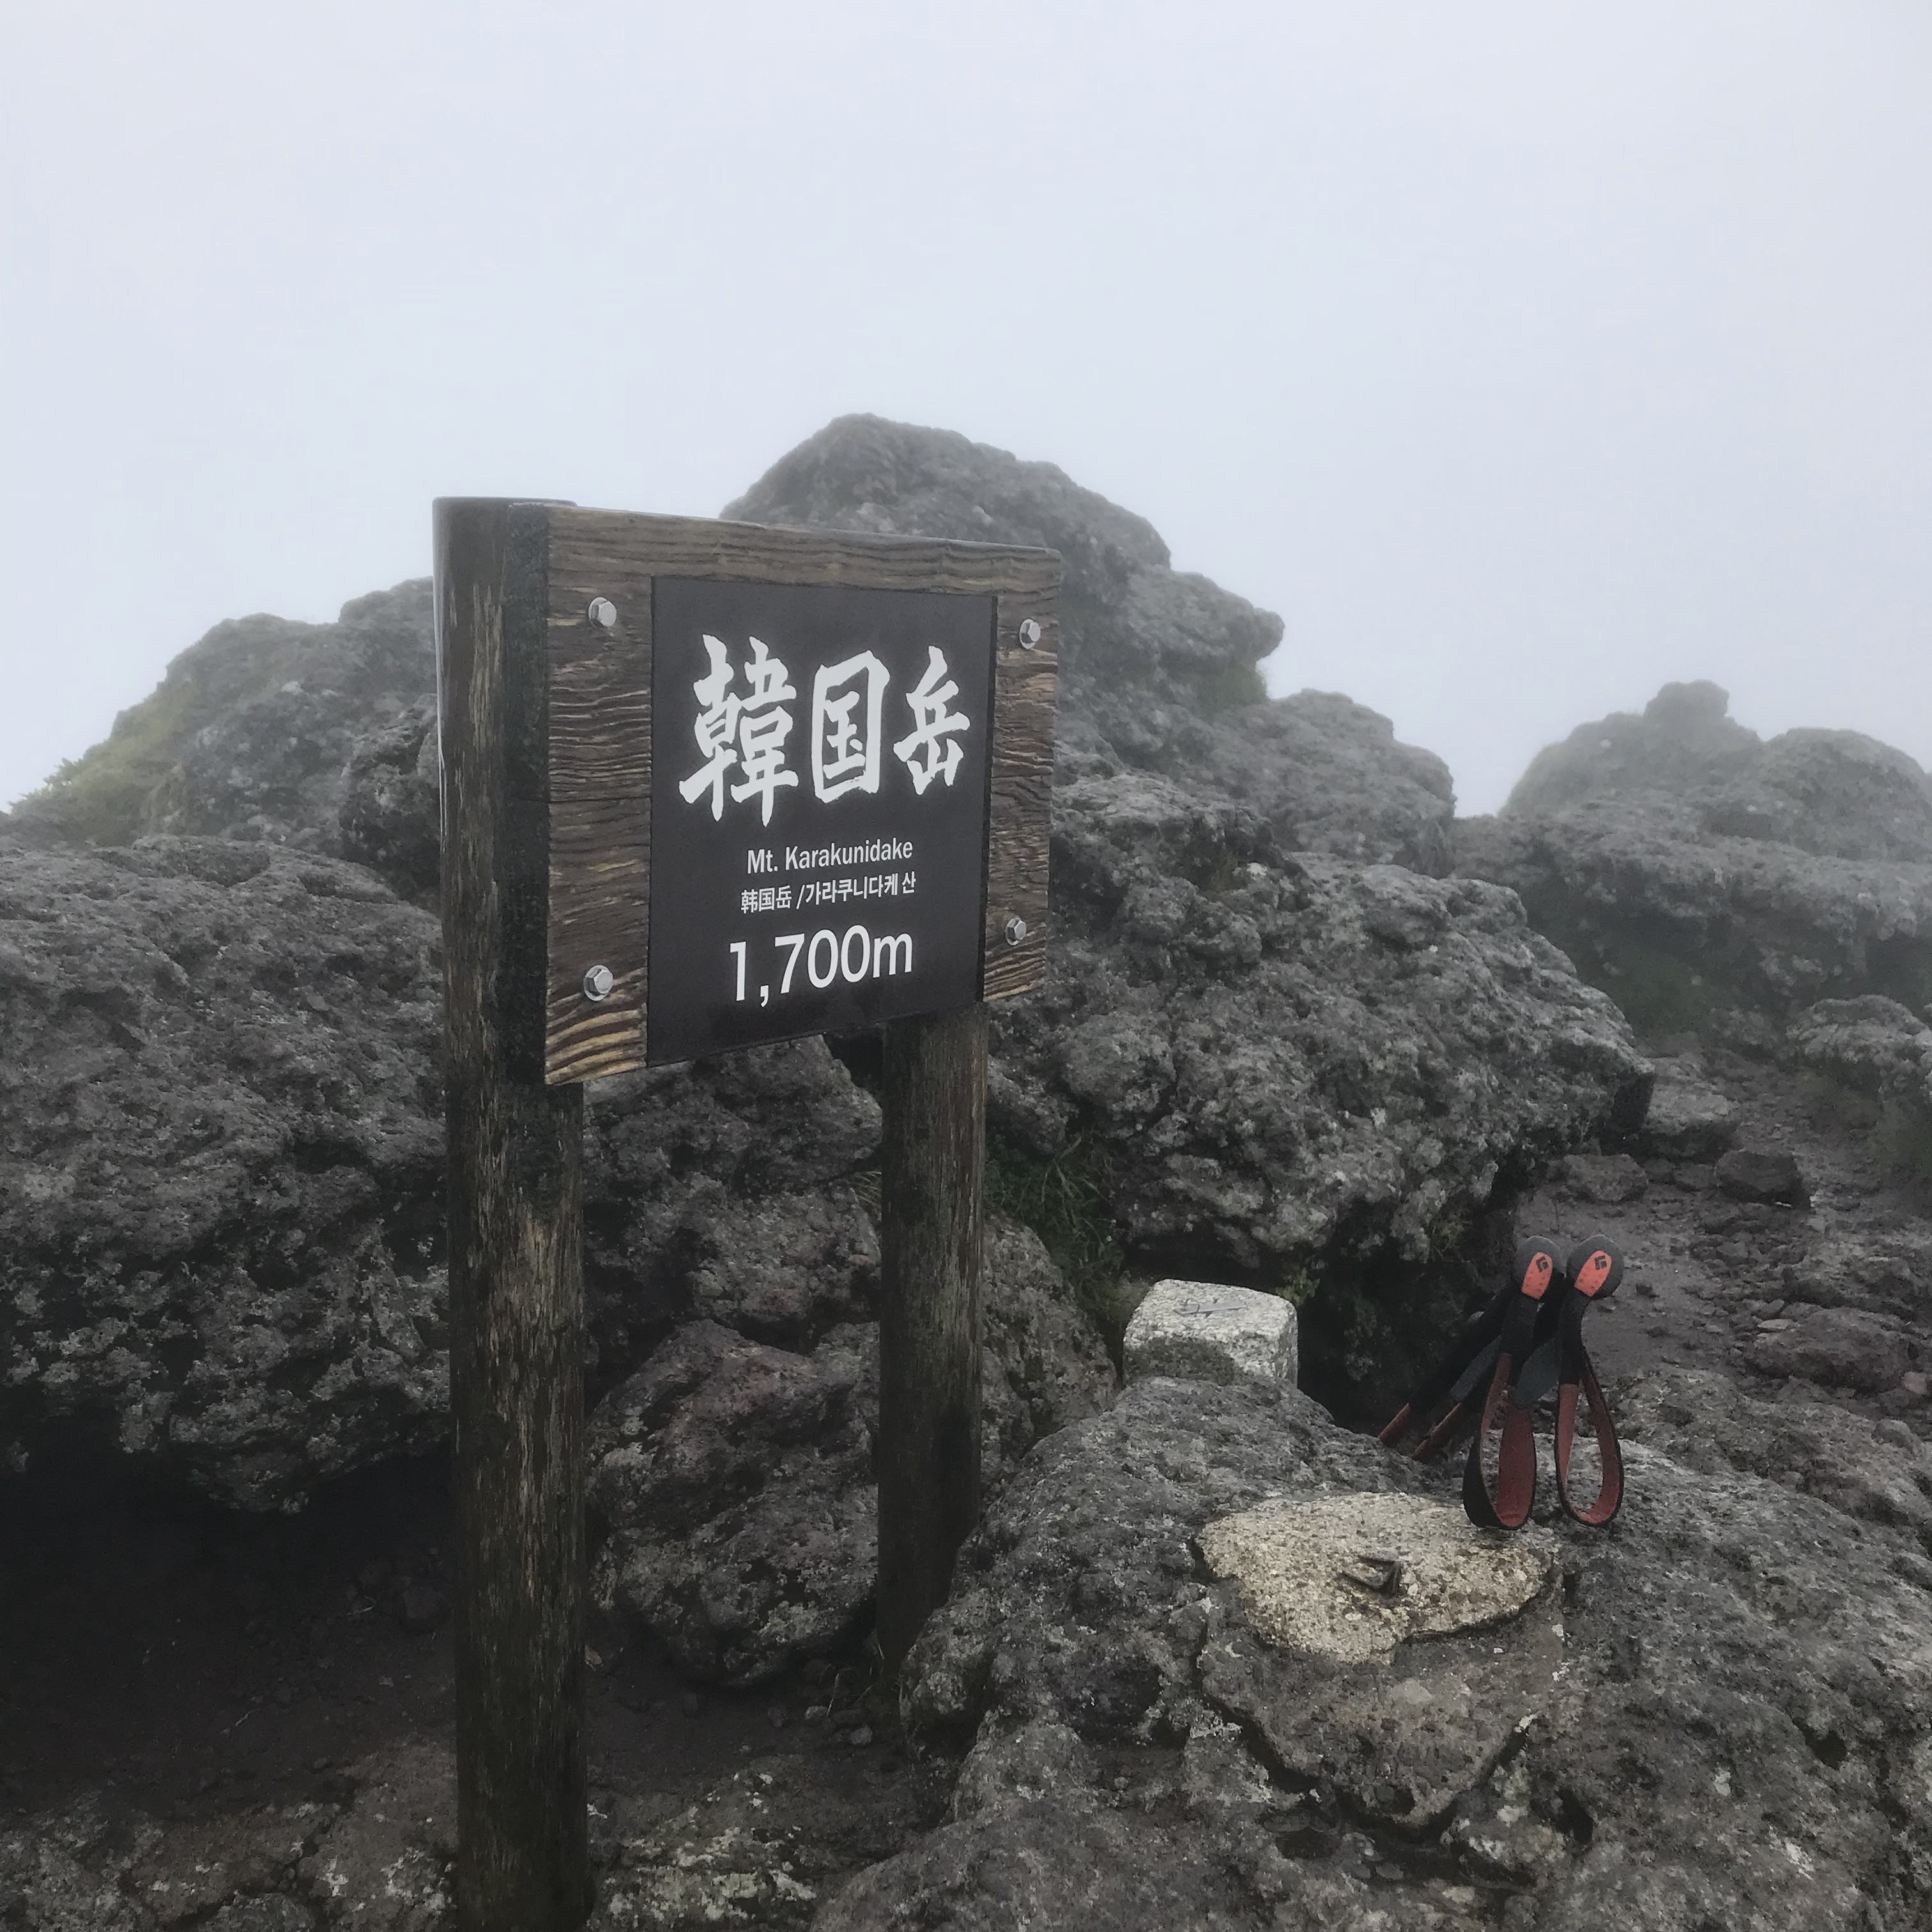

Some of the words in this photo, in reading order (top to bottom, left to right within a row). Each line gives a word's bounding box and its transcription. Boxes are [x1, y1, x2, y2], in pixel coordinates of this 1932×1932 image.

[678, 634, 970, 827] 韓国岳
[747, 848, 778, 874] Mt.
[785, 837, 913, 871] Karakunidake
[901, 871, 916, 894] 산
[730, 924, 912, 1008] 1,700m
